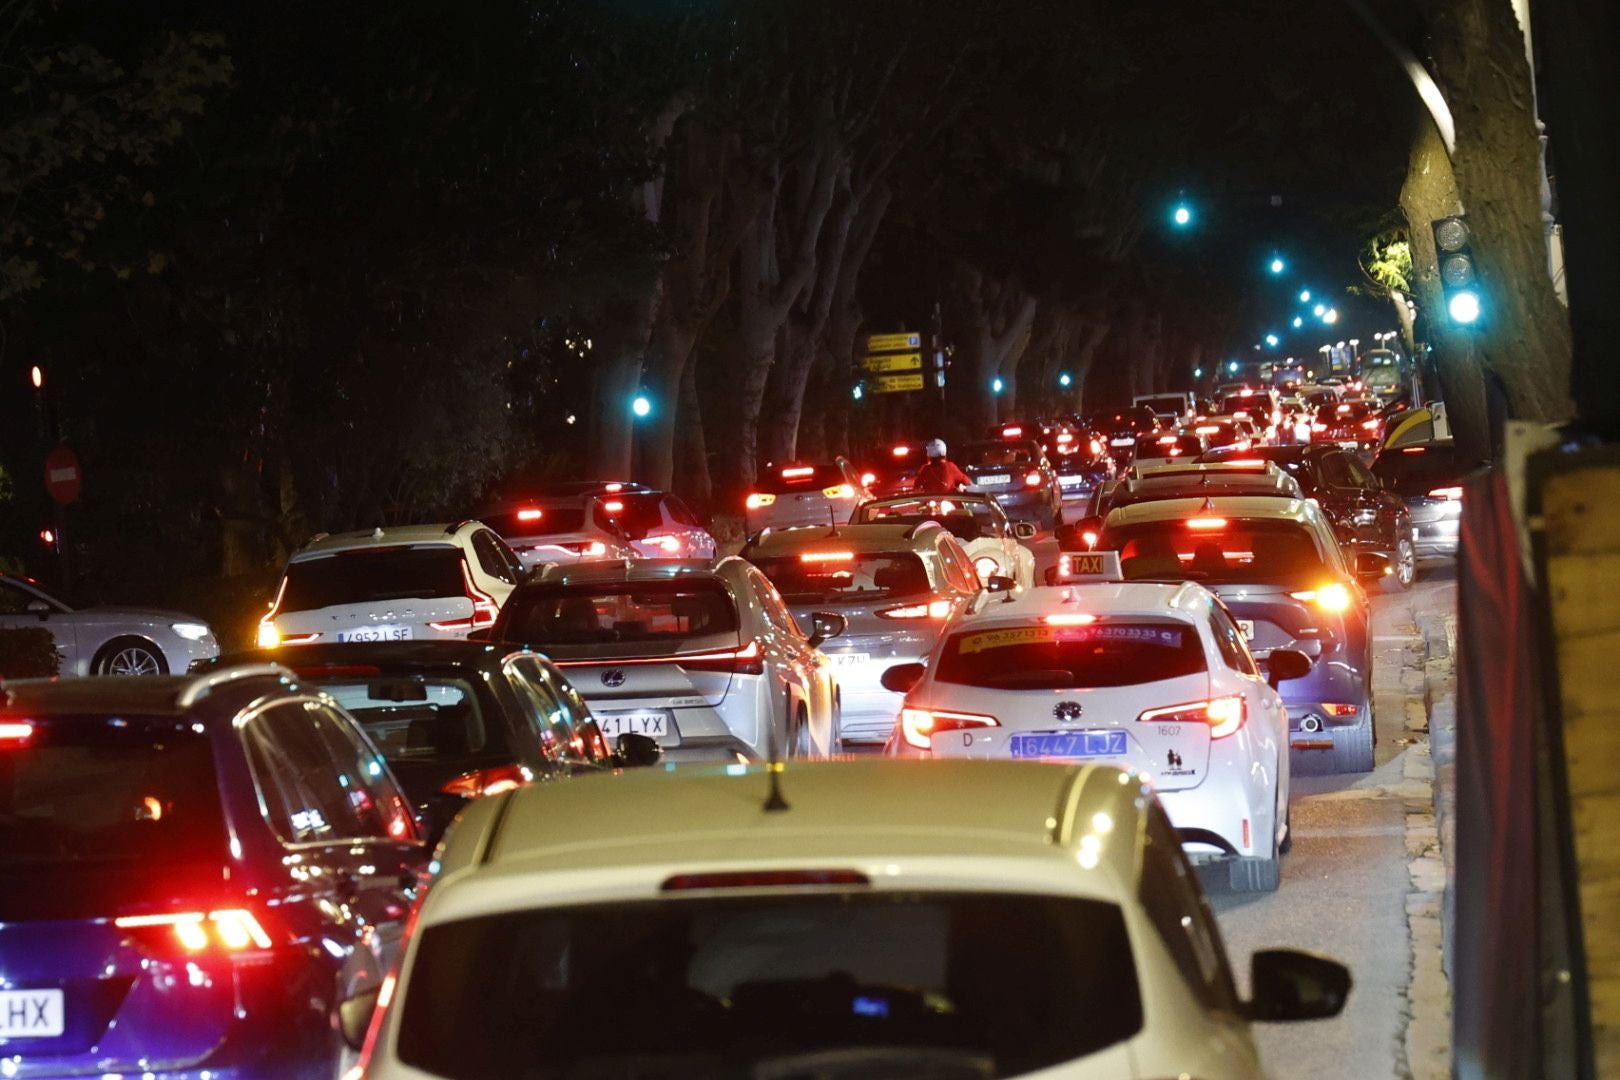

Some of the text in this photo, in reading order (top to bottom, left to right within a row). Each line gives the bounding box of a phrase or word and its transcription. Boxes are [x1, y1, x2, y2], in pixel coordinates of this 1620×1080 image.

[1073, 556, 1104, 573] TAXI
[597, 716, 663, 734] 41 LYX
[1158, 725, 1181, 736] 1607
[963, 732, 974, 748] D
[1026, 733, 1123, 756] 6447 LJZ
[0, 997, 50, 1029] HX
